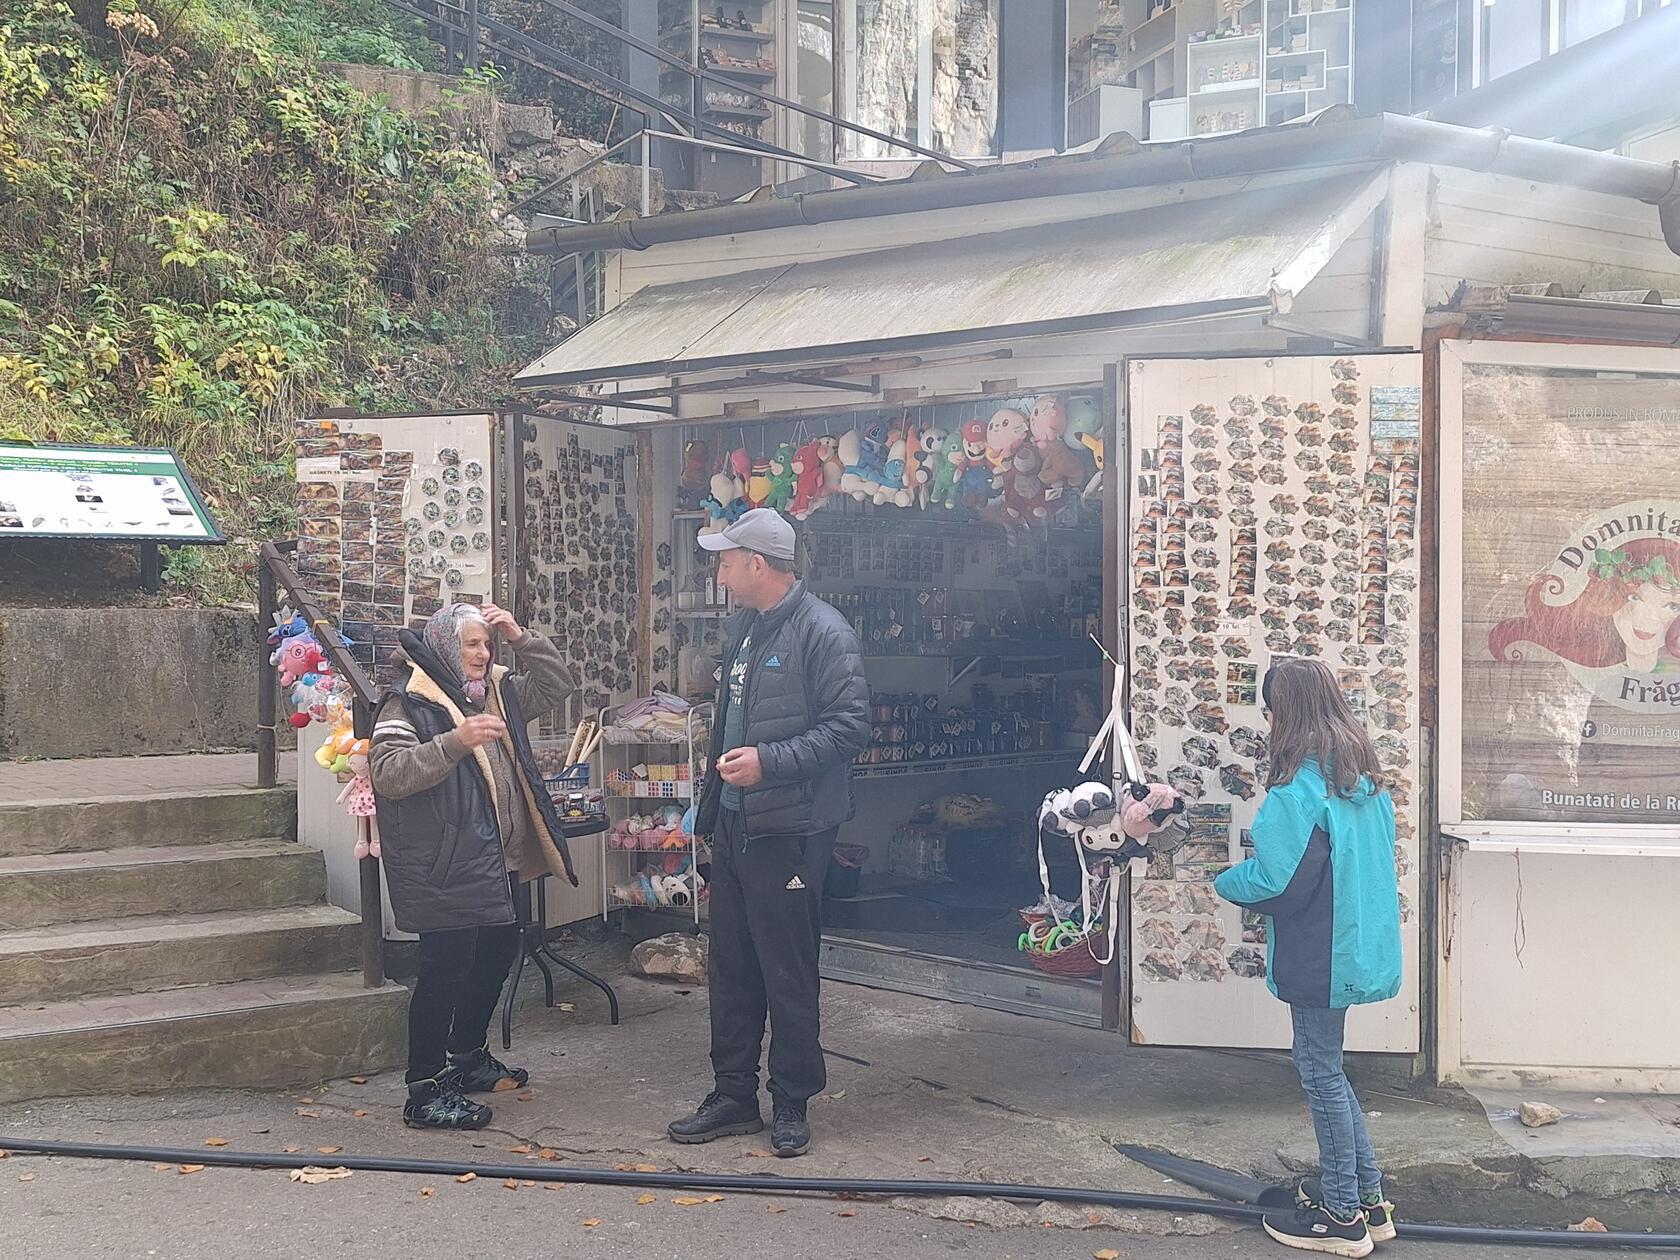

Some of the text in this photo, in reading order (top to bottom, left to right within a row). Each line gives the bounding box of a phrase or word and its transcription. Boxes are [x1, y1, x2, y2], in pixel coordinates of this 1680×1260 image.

[1567, 406, 1620, 420] PRODUS
[1541, 790, 1615, 808] Bunatati
[1620, 793, 1641, 809] de
[1645, 794, 1660, 810] la
